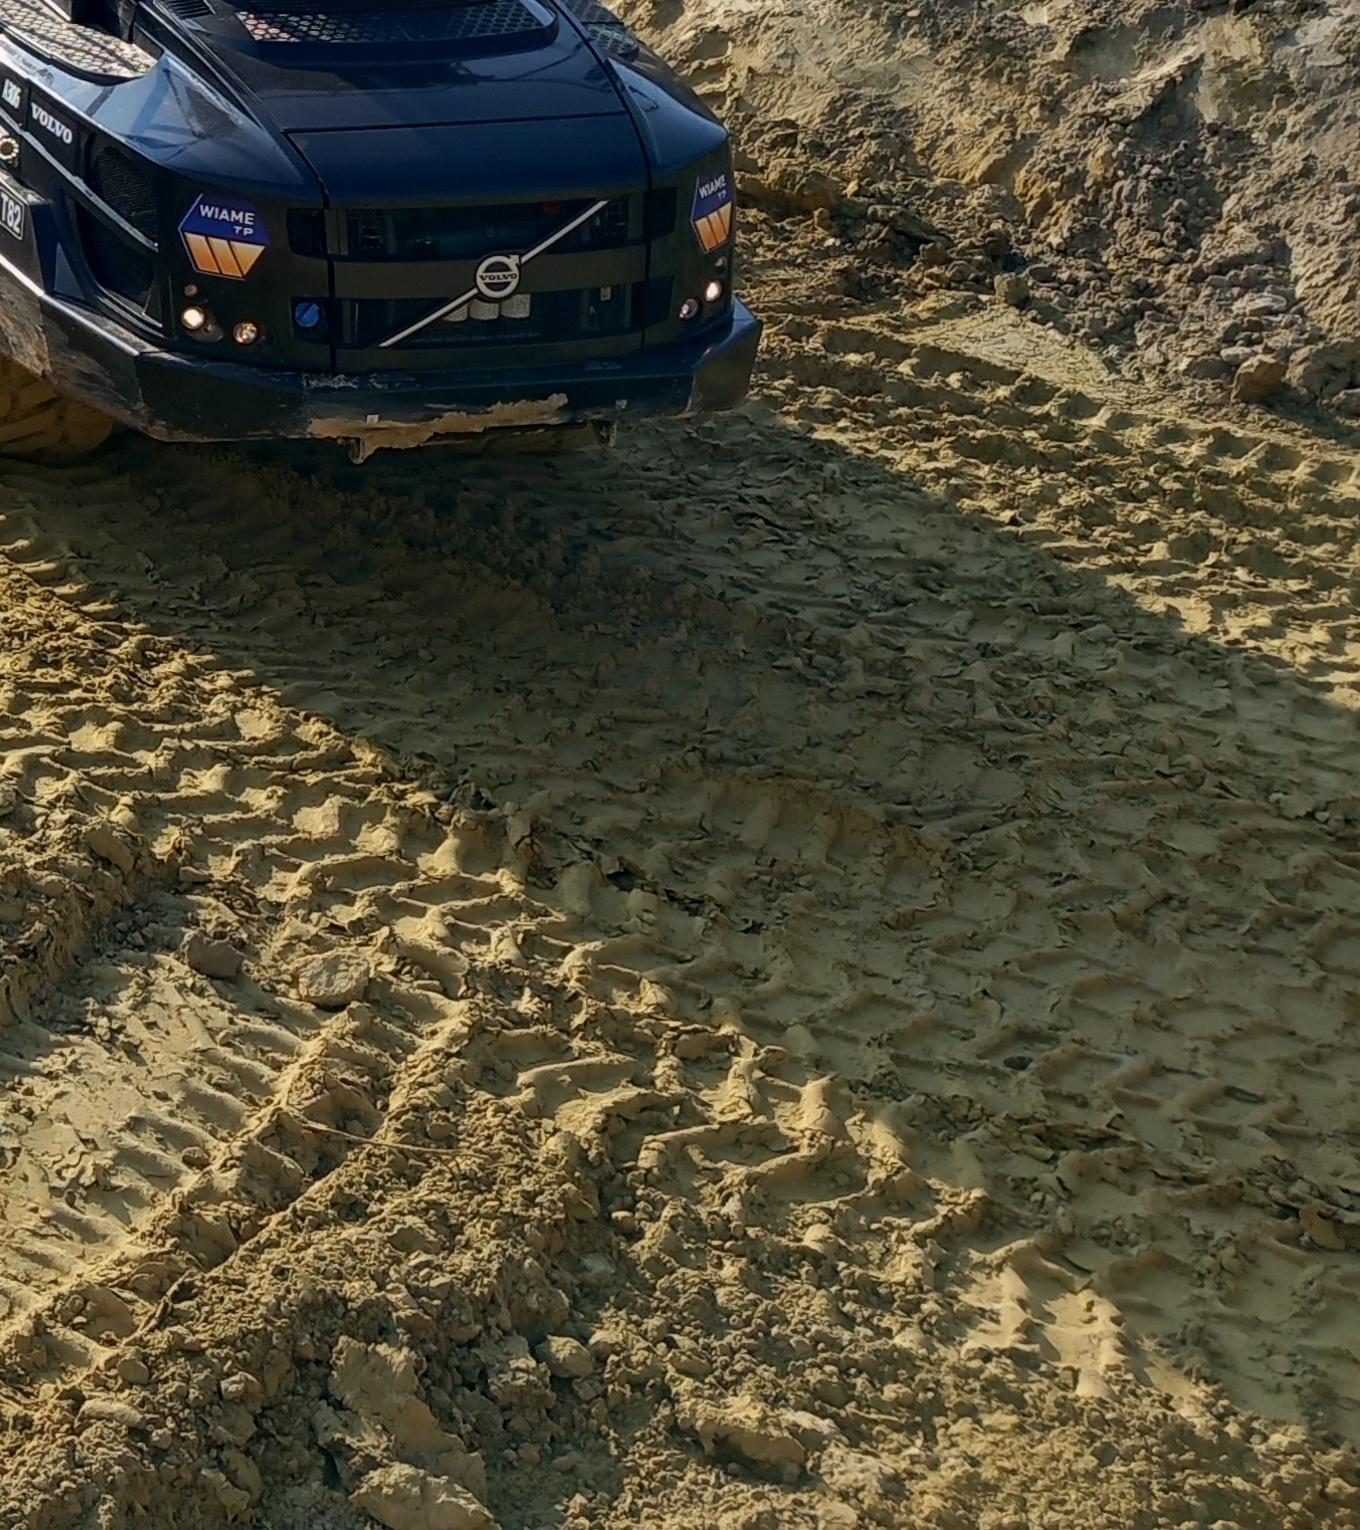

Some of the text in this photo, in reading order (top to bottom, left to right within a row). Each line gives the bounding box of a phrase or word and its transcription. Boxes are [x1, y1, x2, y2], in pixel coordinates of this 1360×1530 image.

[31, 102, 73, 144] VOLVO
[699, 174, 726, 199] WIAME
[0, 191, 21, 234] T82
[200, 204, 255, 225] WIAME
[233, 225, 254, 236] TP
[479, 273, 518, 281] VOLVO
